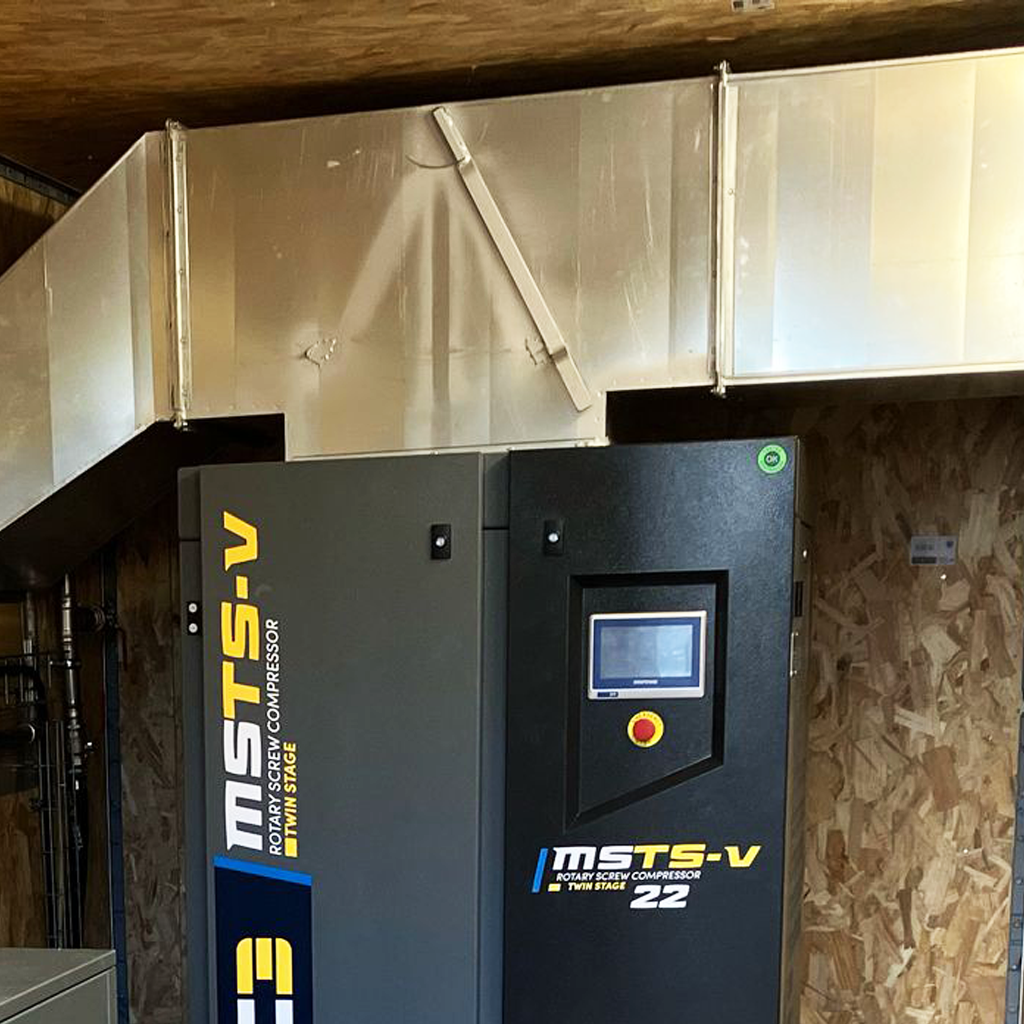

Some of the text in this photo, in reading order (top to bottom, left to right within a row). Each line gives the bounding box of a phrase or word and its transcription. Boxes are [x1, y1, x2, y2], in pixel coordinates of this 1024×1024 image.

[221, 511, 263, 850] MSTS-V
[265, 619, 283, 855] ROTARY SCREW COMPRESSOR
[283, 742, 297, 836] TWIN STAGE
[552, 843, 762, 870] MSTS-V
[556, 870, 702, 882] ROTARY SCREW COMPRESSOR
[568, 881, 626, 891] TWIN STAGE
[629, 884, 690, 909] 22
